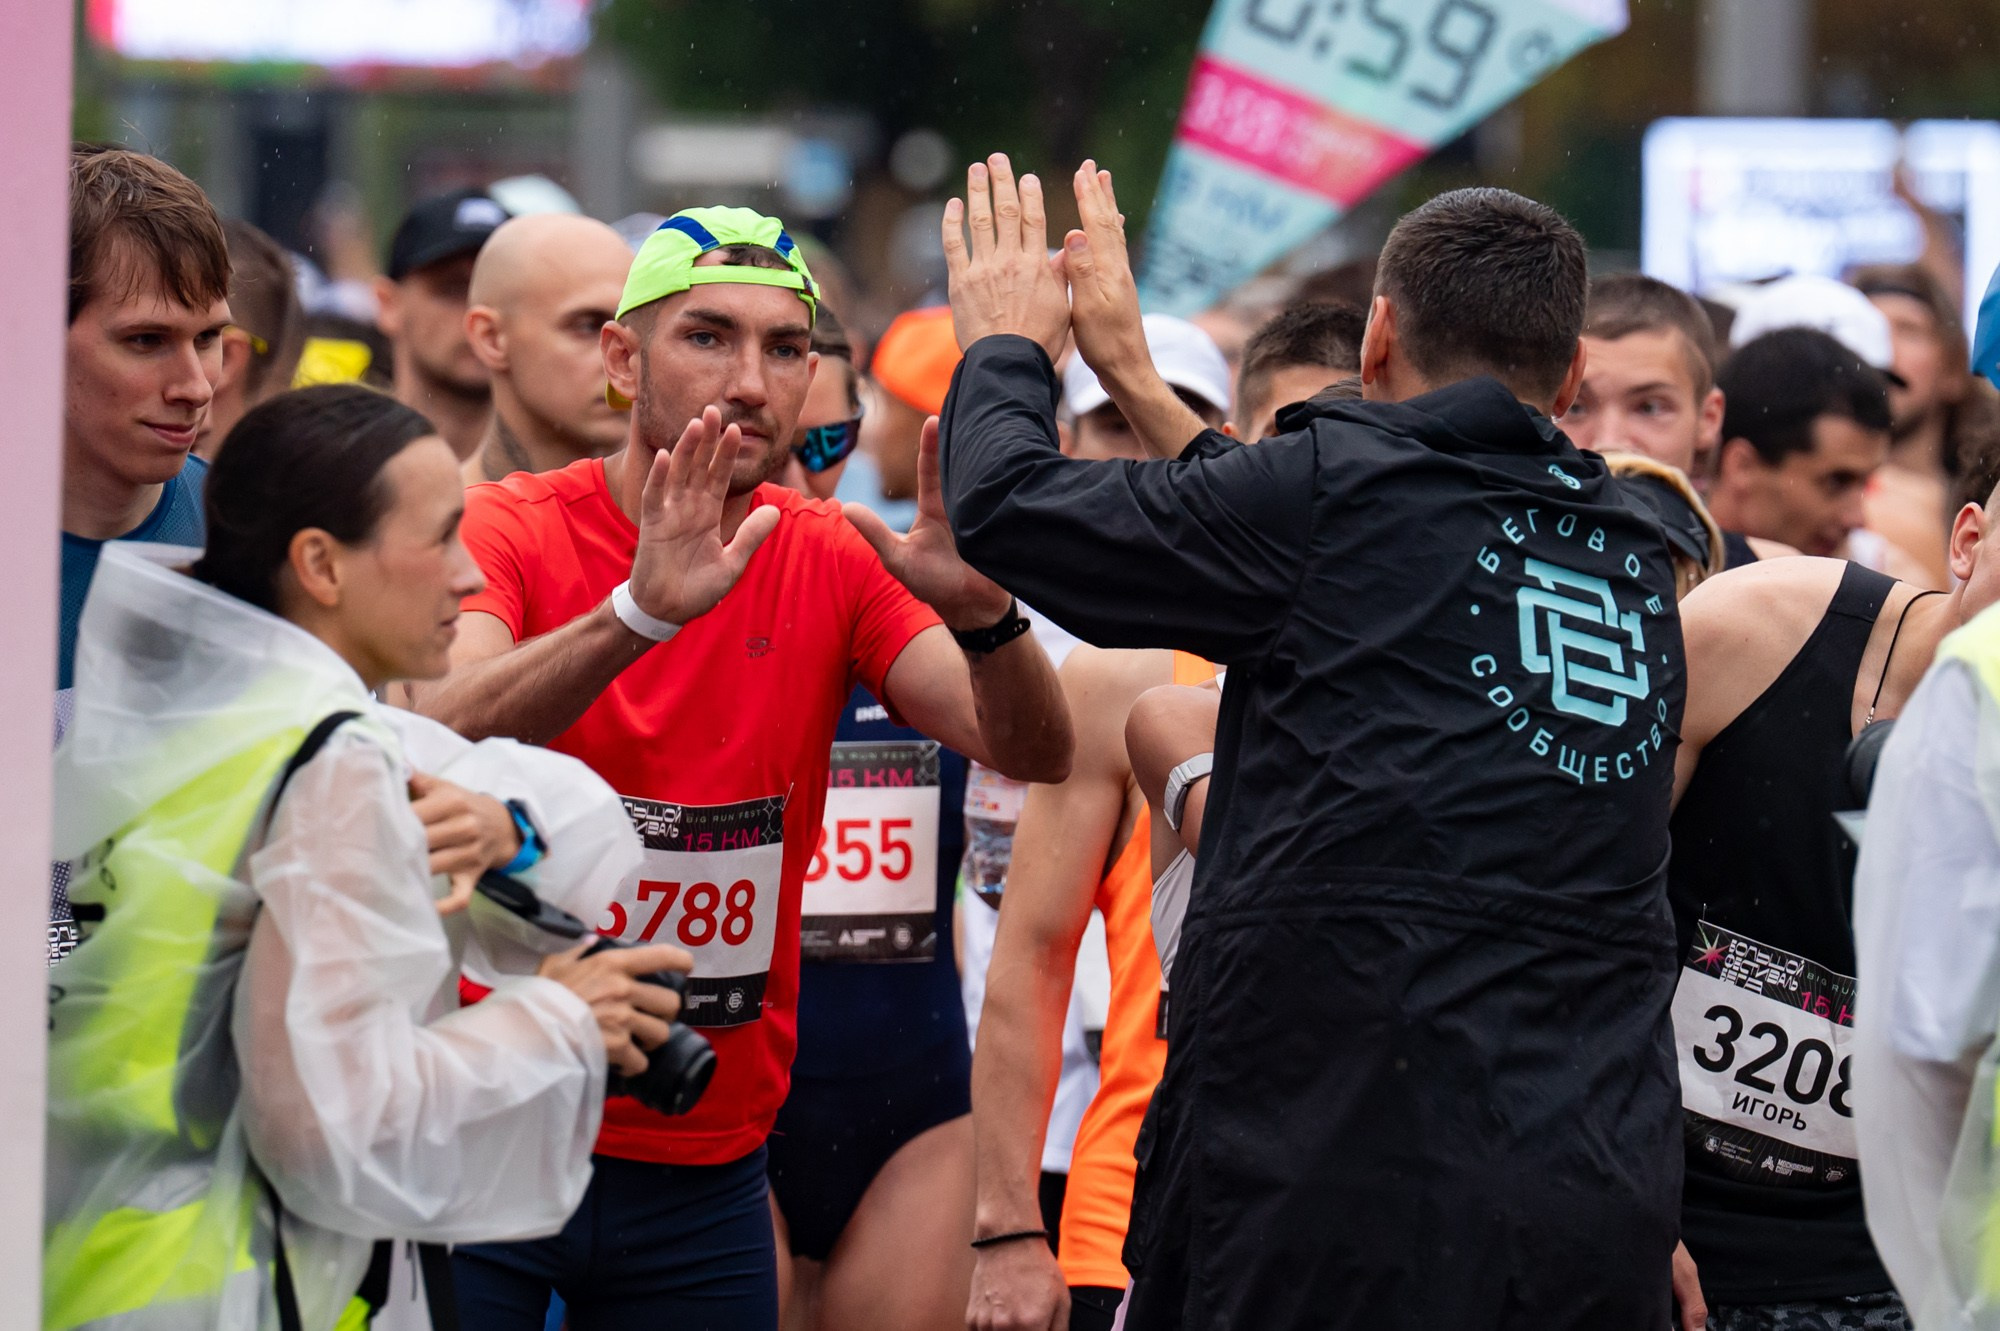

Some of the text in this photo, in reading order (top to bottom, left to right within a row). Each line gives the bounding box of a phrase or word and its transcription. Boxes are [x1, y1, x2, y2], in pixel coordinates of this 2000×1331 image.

[1476, 508, 1663, 615] БЕГОВОЕ
[1471, 653, 1667, 784] СООБЩЕСТВО
[624, 802, 682, 824] ЛЬШОЙ
[712, 813, 734, 823] RUN
[738, 809, 762, 820] FEST
[683, 832, 713, 852] 15
[1724, 953, 1799, 992] ФЕСТИВАЛЬ
[1729, 938, 1805, 977] БОЛЬШОЙ
[1807, 972, 1827, 987] BIG
[1801, 991, 1831, 1019] 15
[1731, 1091, 1807, 1131] ИГОРЬ
